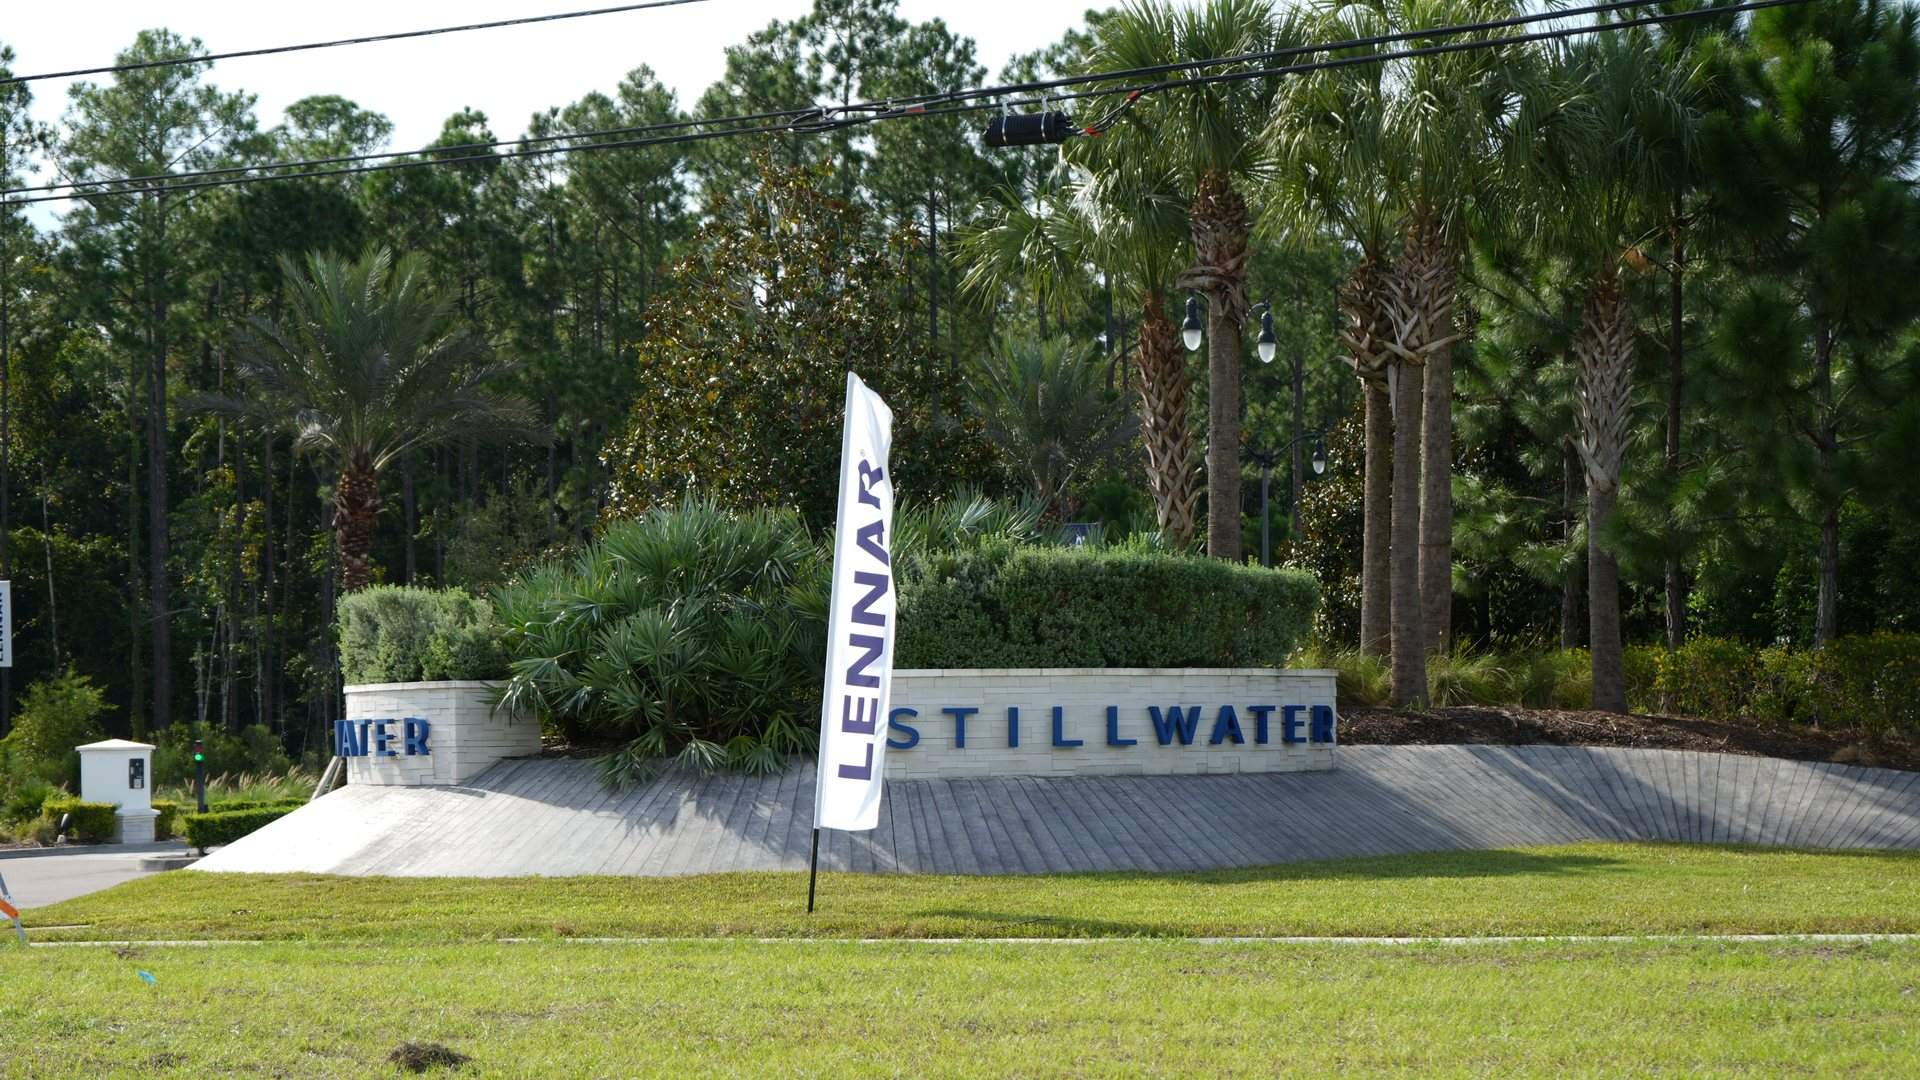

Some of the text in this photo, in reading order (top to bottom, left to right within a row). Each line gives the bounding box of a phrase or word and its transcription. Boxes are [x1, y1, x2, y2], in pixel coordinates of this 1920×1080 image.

[837, 458, 889, 781] LENNAR
[334, 717, 430, 757] ATER
[886, 705, 1334, 750] STILLWATER
